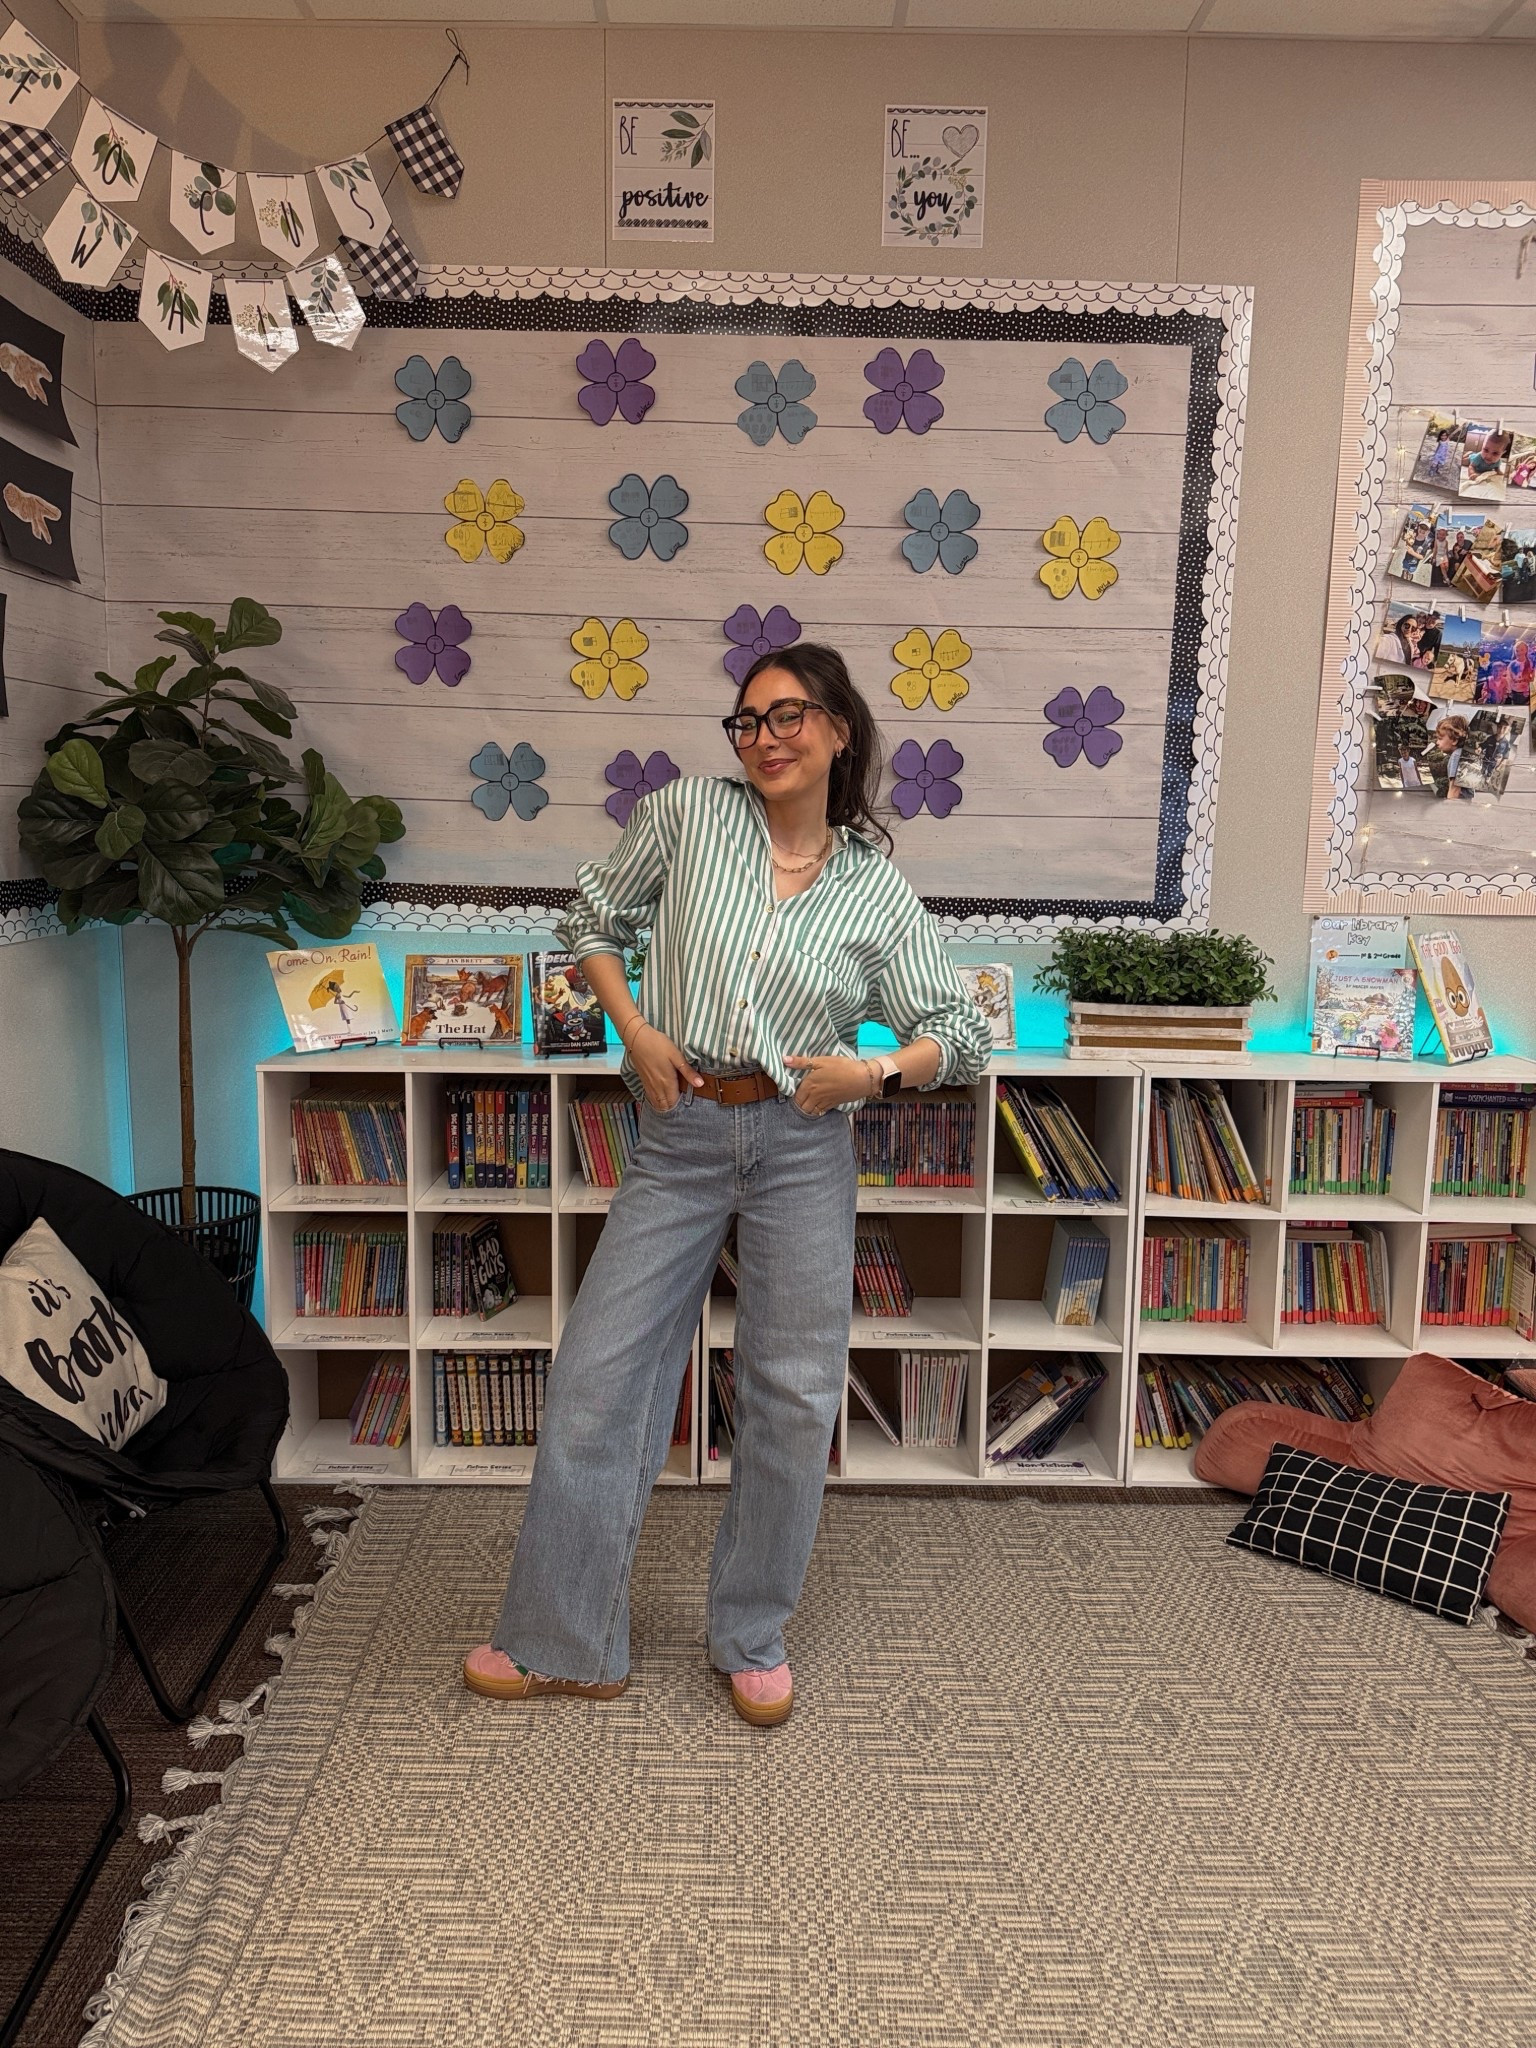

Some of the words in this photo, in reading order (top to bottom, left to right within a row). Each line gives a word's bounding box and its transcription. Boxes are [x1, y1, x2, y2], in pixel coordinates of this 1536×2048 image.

[620, 115, 639, 155] BE
[619, 182, 709, 219] positive
[913, 190, 953, 221] you
[1321, 918, 1348, 930] Our
[1347, 932, 1371, 946] Key
[277, 953, 309, 974] Come
[338, 946, 371, 963] Rain!
[1361, 975, 1399, 984] SNOWMAN
[436, 1024, 461, 1034] The
[462, 1024, 486, 1034] Hat
[477, 1113, 485, 1124] DOG
[497, 1113, 505, 1124] DOG
[477, 1124, 485, 1134] MAN
[497, 1125, 505, 1135] MAN
[478, 1238, 499, 1265] BAD
[478, 1253, 507, 1285] GUYS
[27, 1278, 72, 1318] it's
[24, 1295, 134, 1405] Book
[1017, 1462, 1074, 1470] Non-Fiction
